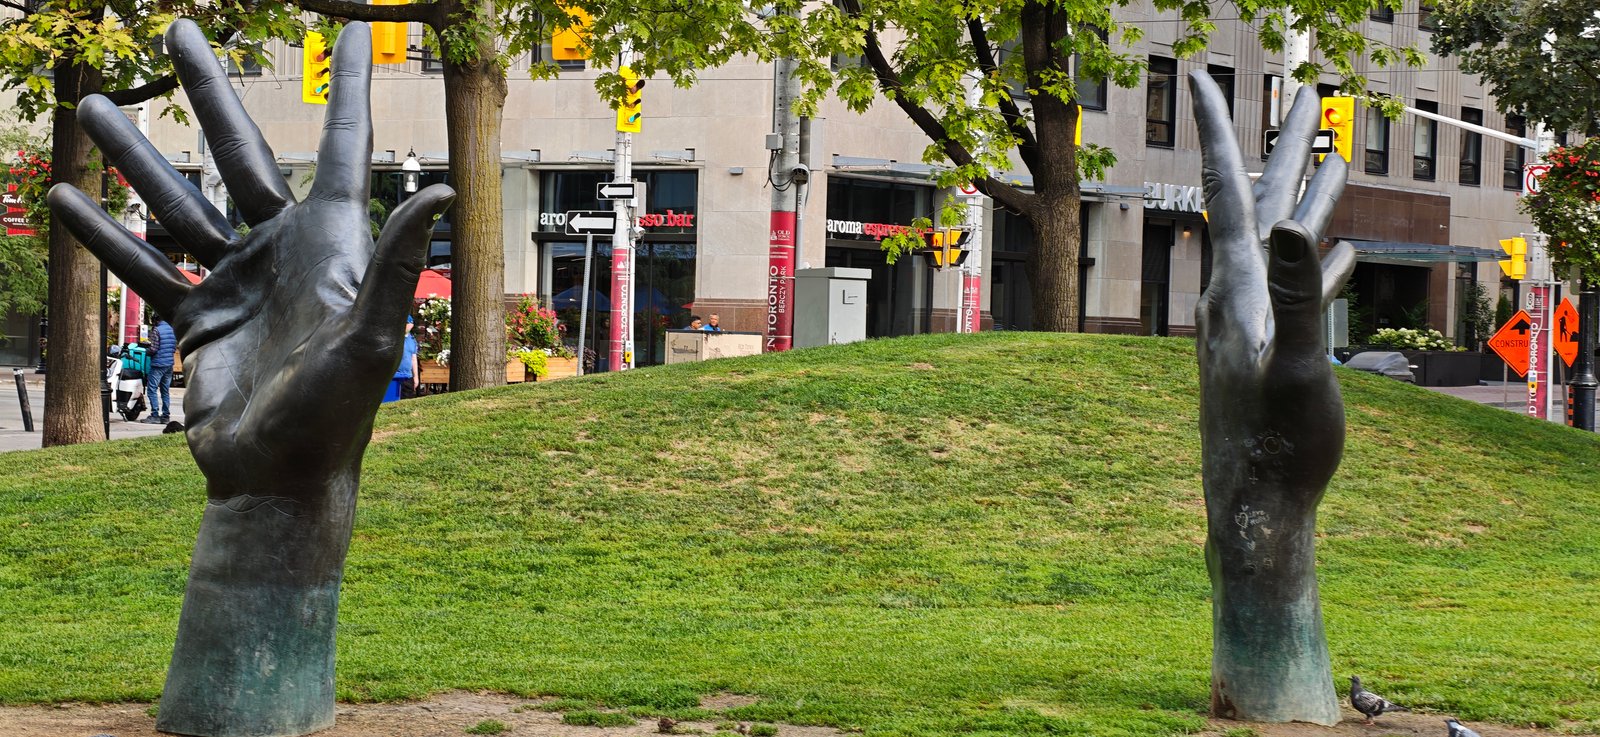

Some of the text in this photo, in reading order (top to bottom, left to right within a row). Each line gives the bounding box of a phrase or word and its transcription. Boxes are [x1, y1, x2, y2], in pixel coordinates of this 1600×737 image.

[540, 212, 566, 226] aro
[667, 209, 695, 227] bar
[827, 219, 863, 235] aroma
[620, 284, 629, 329] TORONTO
[767, 265, 779, 332] TORONTO
[778, 286, 786, 314] BERCZY
[965, 309, 973, 333] ONTO
[1495, 340, 1529, 348] CONSTRU
[1528, 322, 1539, 369] TORONTO
